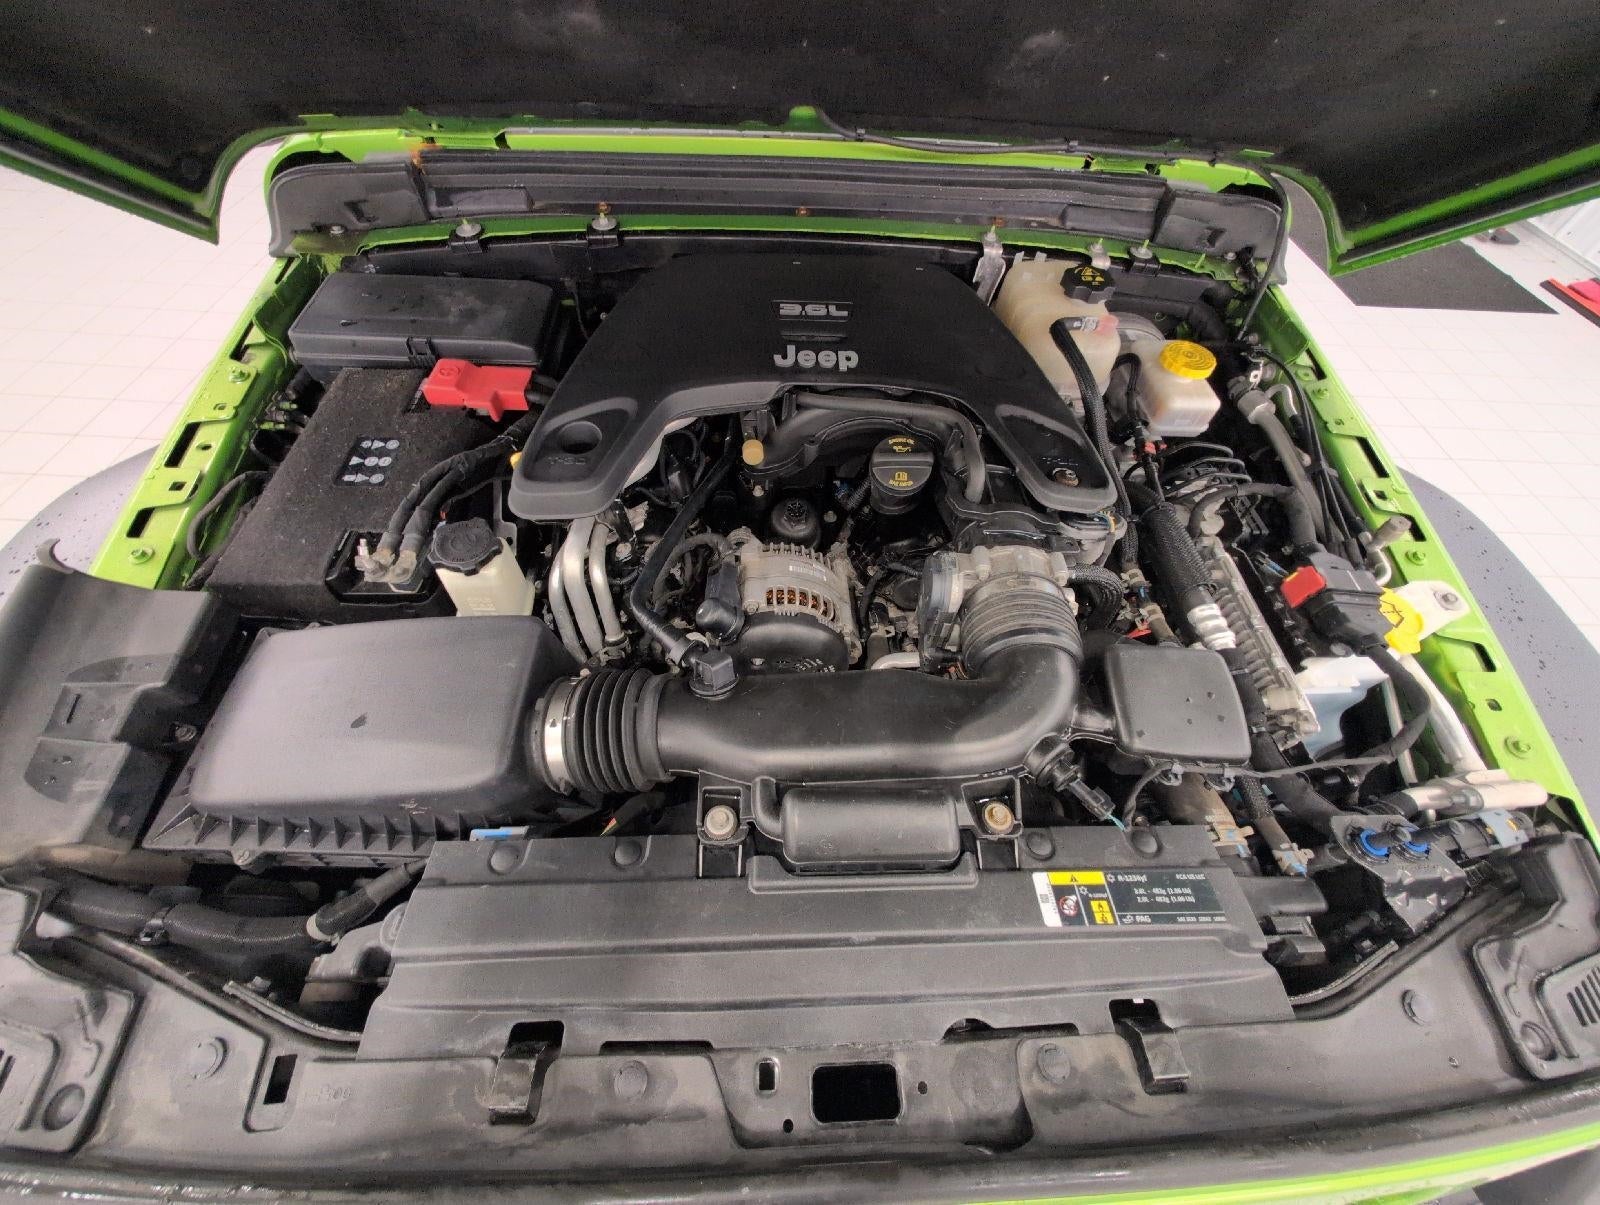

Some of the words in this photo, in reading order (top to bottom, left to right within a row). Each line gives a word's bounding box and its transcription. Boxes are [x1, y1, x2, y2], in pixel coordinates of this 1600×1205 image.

[779, 303, 849, 317] 3.6L
[773, 344, 859, 372] Jeep
[1135, 915, 1151, 923] PAG
